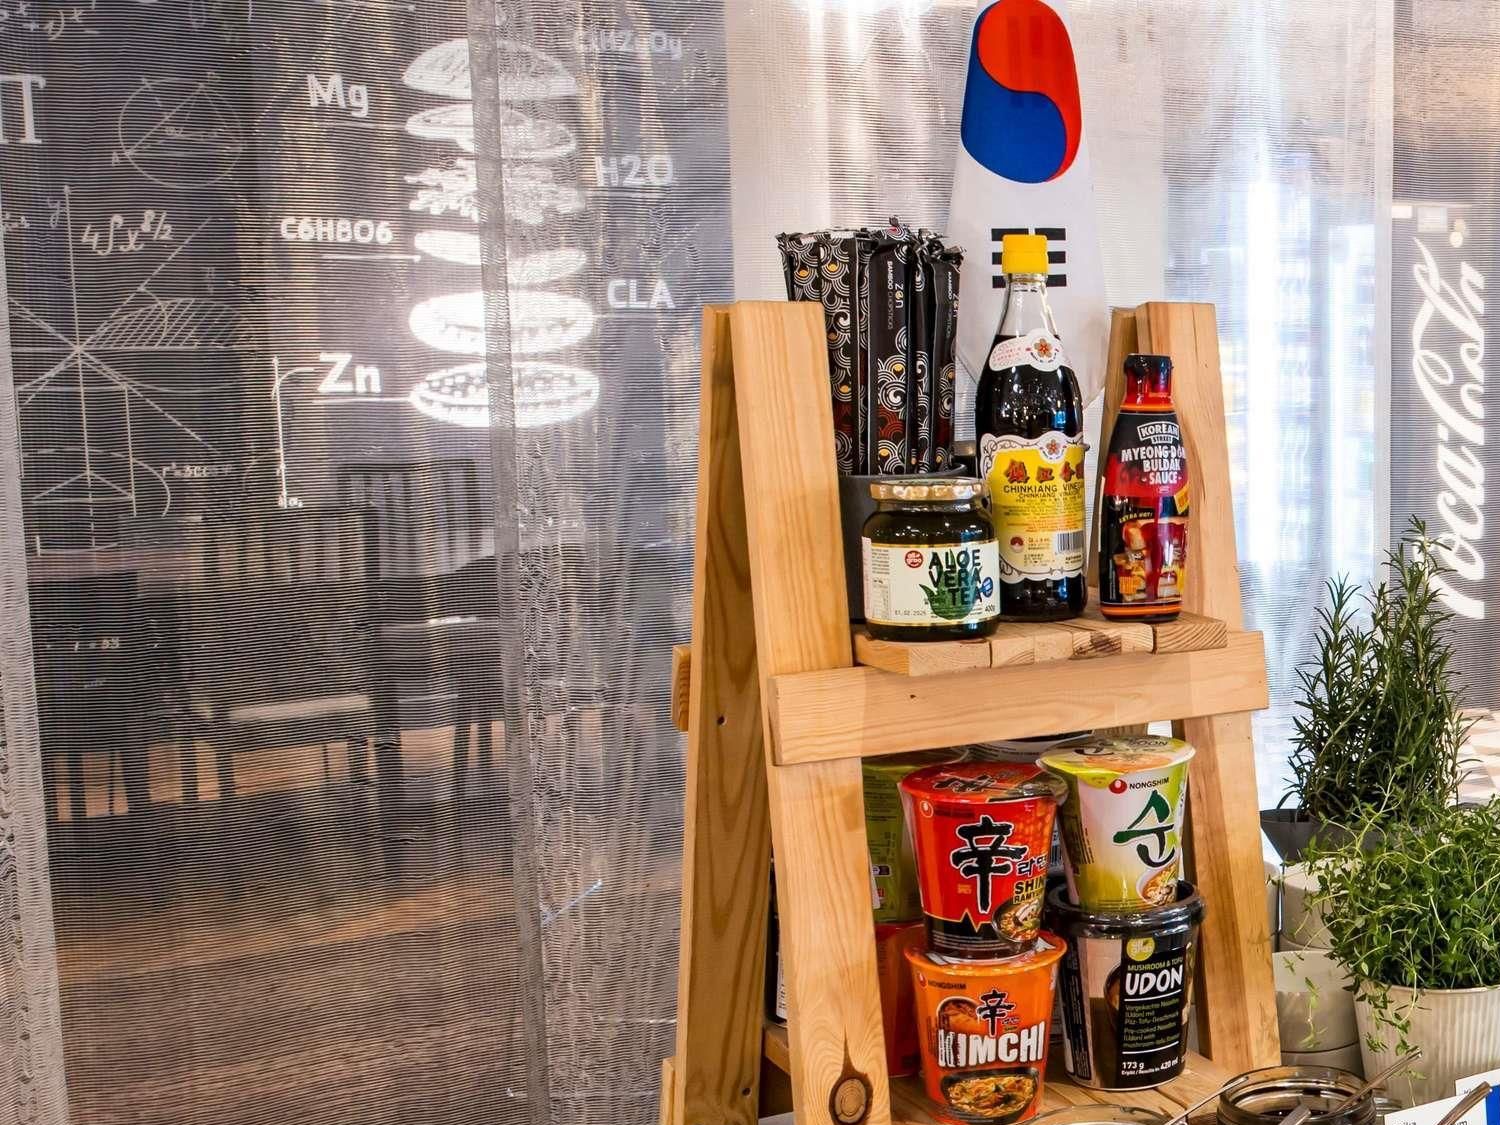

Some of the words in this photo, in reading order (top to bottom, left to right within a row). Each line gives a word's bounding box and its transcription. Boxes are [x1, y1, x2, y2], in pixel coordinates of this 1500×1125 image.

[307, 73, 369, 118] Mg
[594, 154, 674, 187] H2O
[607, 278, 676, 309] CLA
[317, 352, 382, 393] Zn
[1140, 423, 1179, 437] KOREAN
[1143, 458, 1181, 472] BULDAK
[1003, 484, 1058, 493] CHINKIANG
[1149, 471, 1178, 485] SAUCE
[929, 548, 981, 570] ALOE
[928, 566, 982, 588] VERA
[947, 587, 982, 606] TEA
[1129, 777, 1170, 790] NONGSHIM
[950, 814, 1029, 914] 辛
[1127, 961, 1166, 972] MUSHROOM
[1125, 964, 1184, 996] UDON
[937, 1021, 1046, 1068] KIMCHI
[1122, 1061, 1138, 1069] 173
[1139, 1062, 1145, 1070] g
